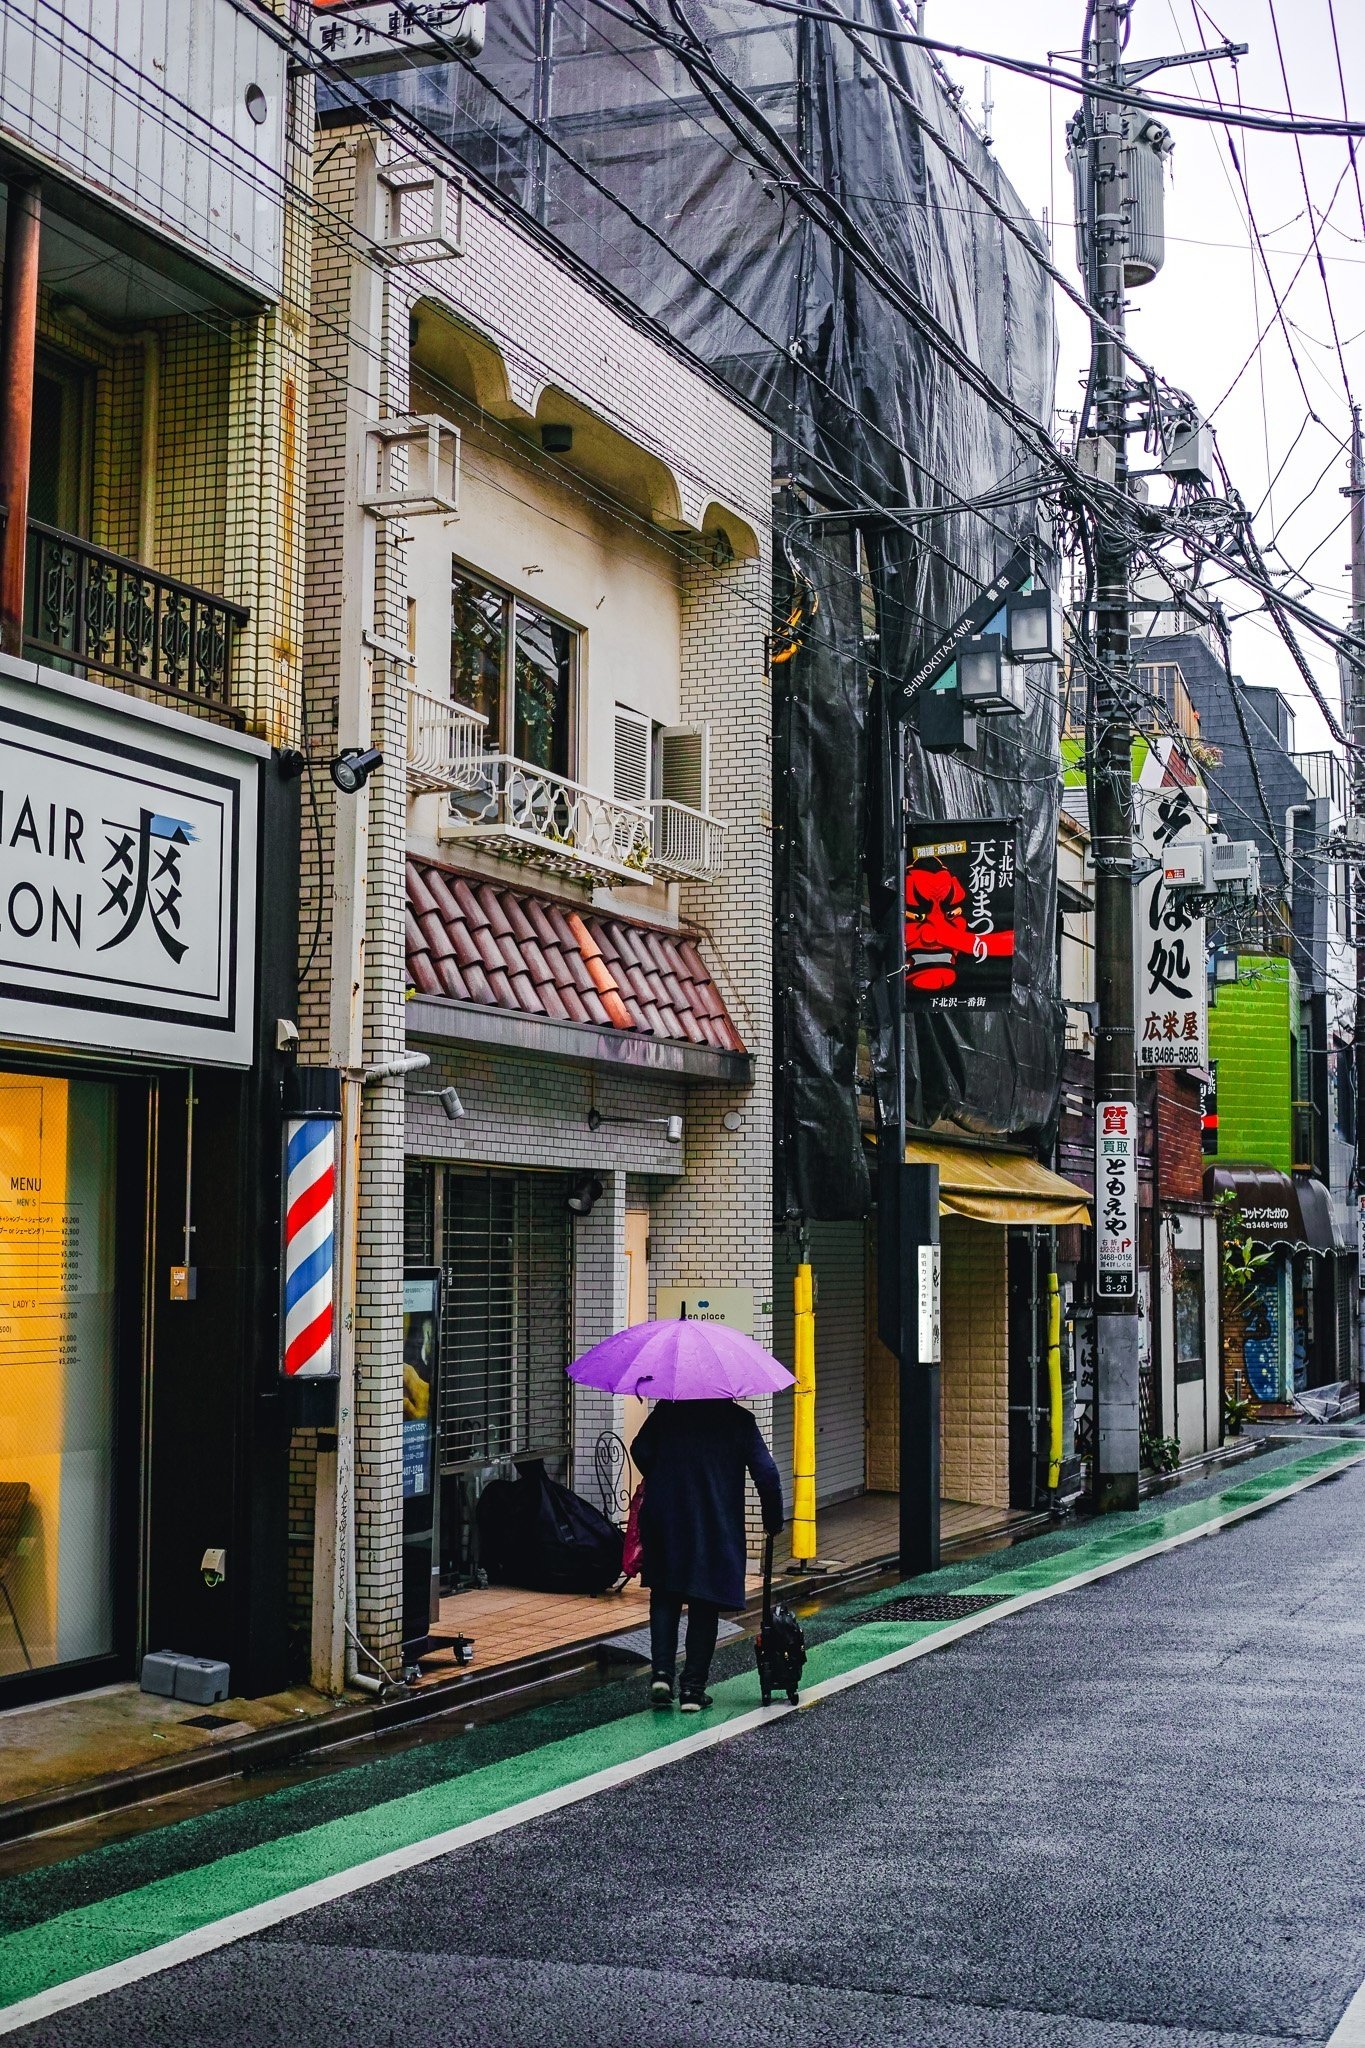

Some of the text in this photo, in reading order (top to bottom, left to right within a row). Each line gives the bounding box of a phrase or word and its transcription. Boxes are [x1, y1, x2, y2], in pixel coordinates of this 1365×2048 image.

[903, 618, 975, 698] SHIMOKITAZAWA
[0, 790, 86, 865] AIR
[999, 839, 1015, 888] 下北沢
[96, 807, 190, 965] 爽
[968, 838, 996, 964] 天狗まつり
[930, 997, 986, 1007] 下北沢一番街
[1142, 1010, 1199, 1042] 広栄屋
[1154, 1046, 1199, 1064] 3466-5958
[1103, 1105, 1128, 1135] 質
[1103, 1140, 1128, 1153] 買取
[10, 1177, 42, 1191] MENU
[1103, 1158, 1127, 1236] ともえや
[1100, 1253, 1133, 1261] 3468-0156
[1105, 1275, 1128, 1283] 北沢
[1106, 1284, 1127, 1292] 3-21
[701, 1312, 726, 1321] place
